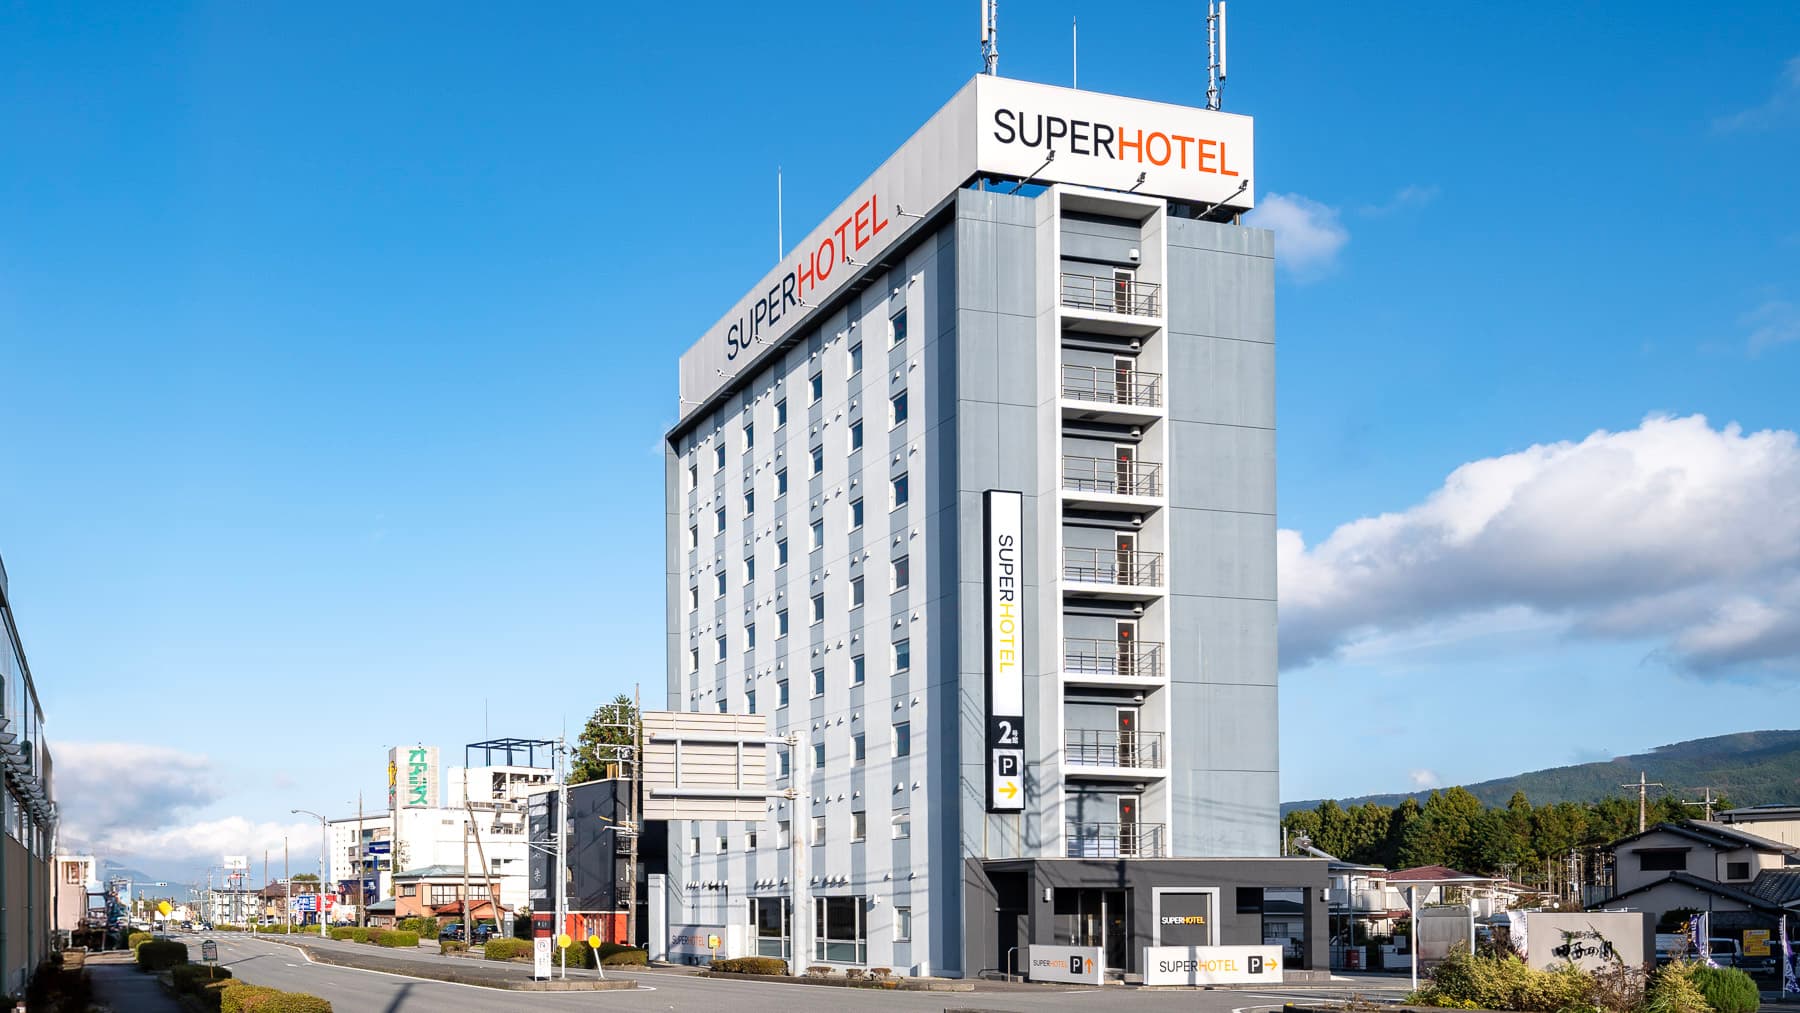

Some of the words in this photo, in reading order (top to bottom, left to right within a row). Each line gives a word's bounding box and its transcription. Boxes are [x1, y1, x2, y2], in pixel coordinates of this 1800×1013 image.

[993, 108, 1239, 177] SUPERHOTEL
[727, 193, 889, 361] SUPERHOTEL
[998, 534, 1015, 673] SUPERHOTEL
[408, 748, 428, 805] オアシス
[1161, 916, 1206, 925] SUPERHOTEL
[671, 935, 705, 947] SUPERHOTEL
[1033, 959, 1068, 969] SUPERHOTEL
[1159, 959, 1239, 973] SUPERHOTEL
